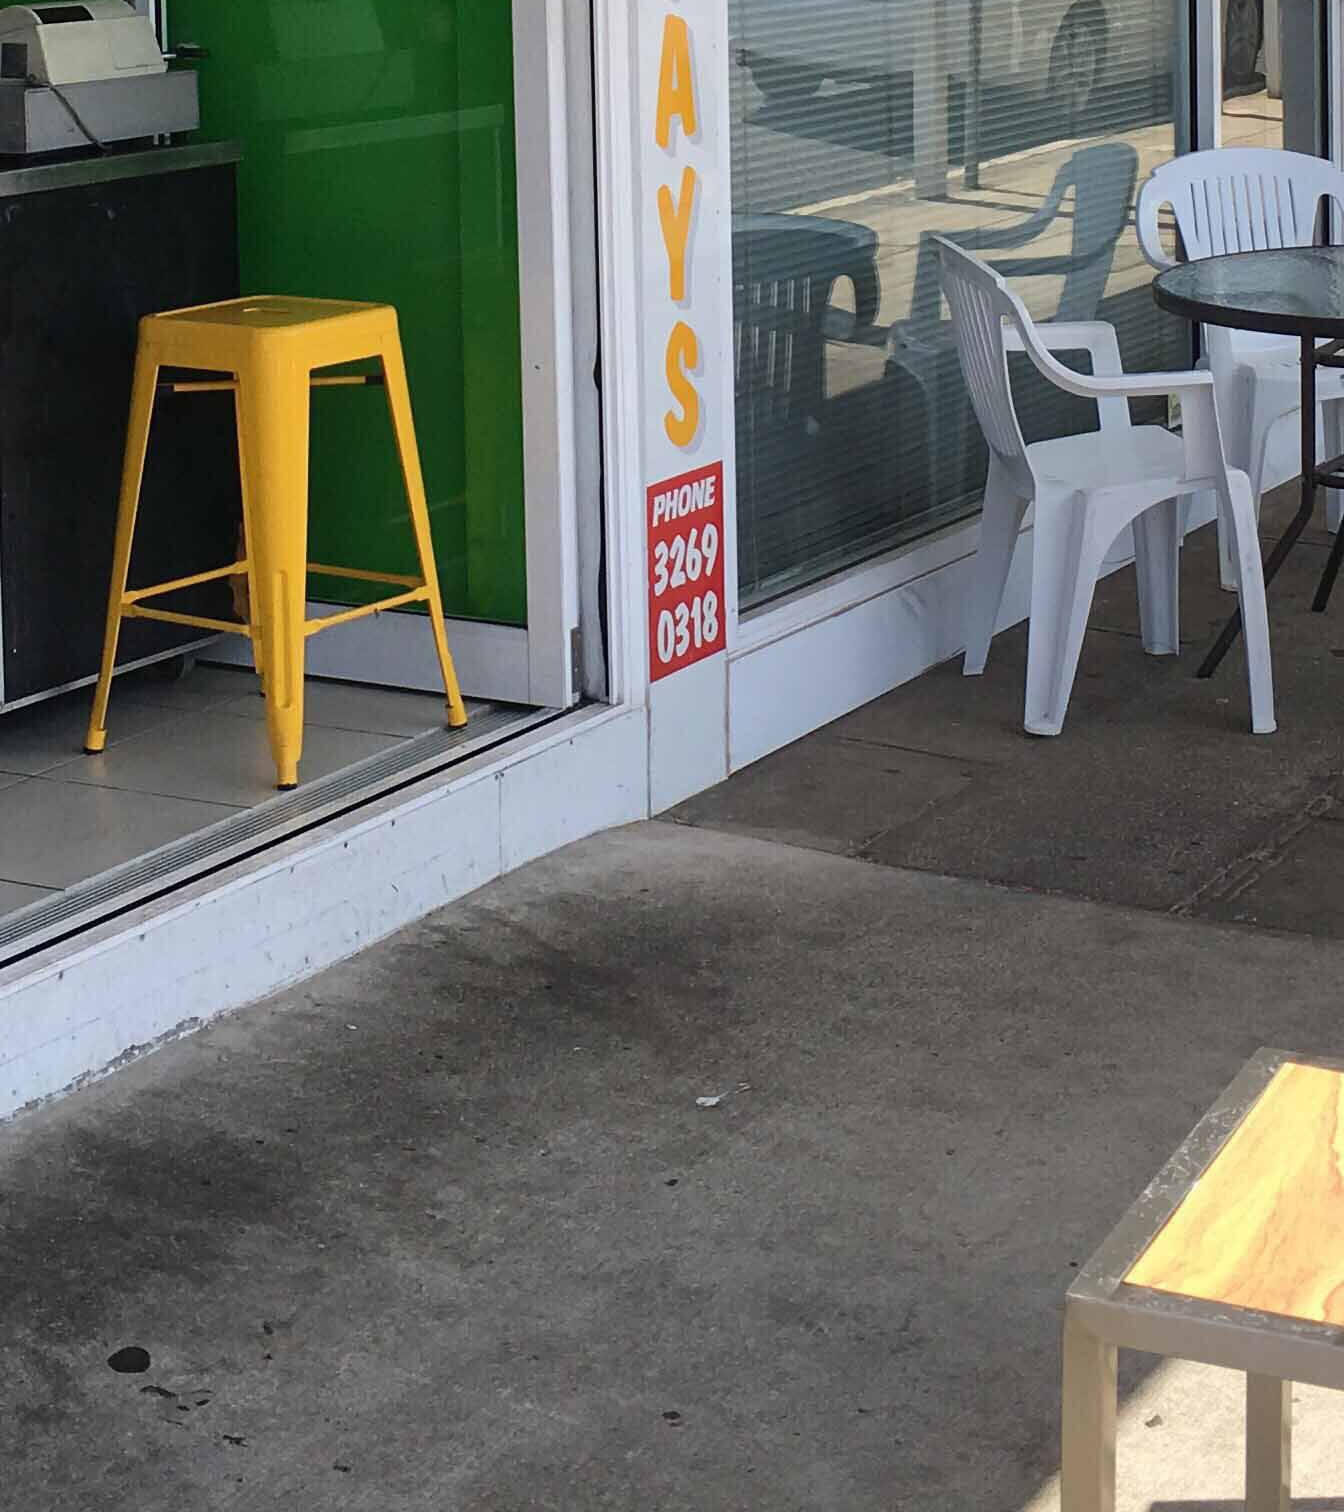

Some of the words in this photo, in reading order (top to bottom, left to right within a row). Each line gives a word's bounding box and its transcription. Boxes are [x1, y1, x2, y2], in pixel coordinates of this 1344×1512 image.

[652, 474, 717, 529] PHONE
[654, 523, 719, 598] 3269
[657, 590, 718, 665] 0318
